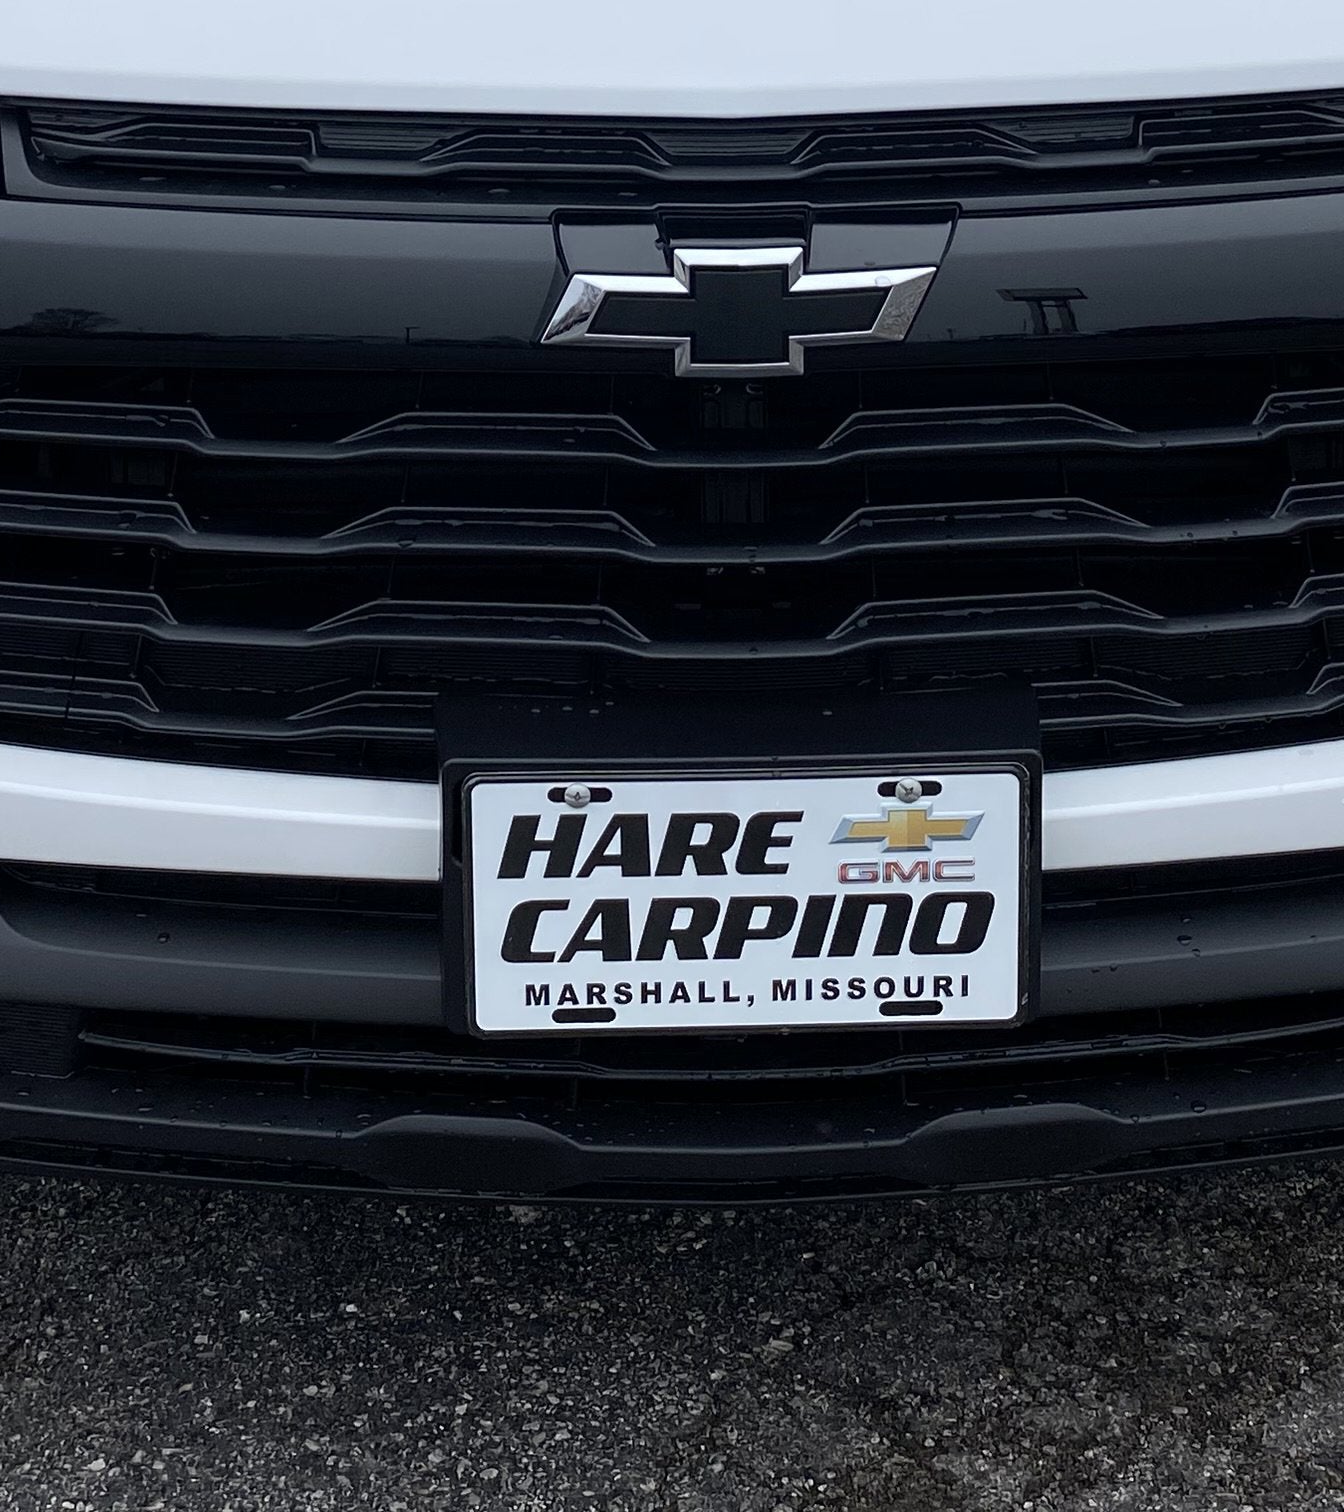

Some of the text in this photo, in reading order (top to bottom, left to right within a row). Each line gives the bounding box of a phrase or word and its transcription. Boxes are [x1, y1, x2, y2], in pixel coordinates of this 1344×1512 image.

[497, 810, 804, 879] HARE
[837, 857, 976, 884] GMC
[500, 891, 996, 963] CARPINO
[525, 974, 970, 1008] MARSHALL, MISSOURI
